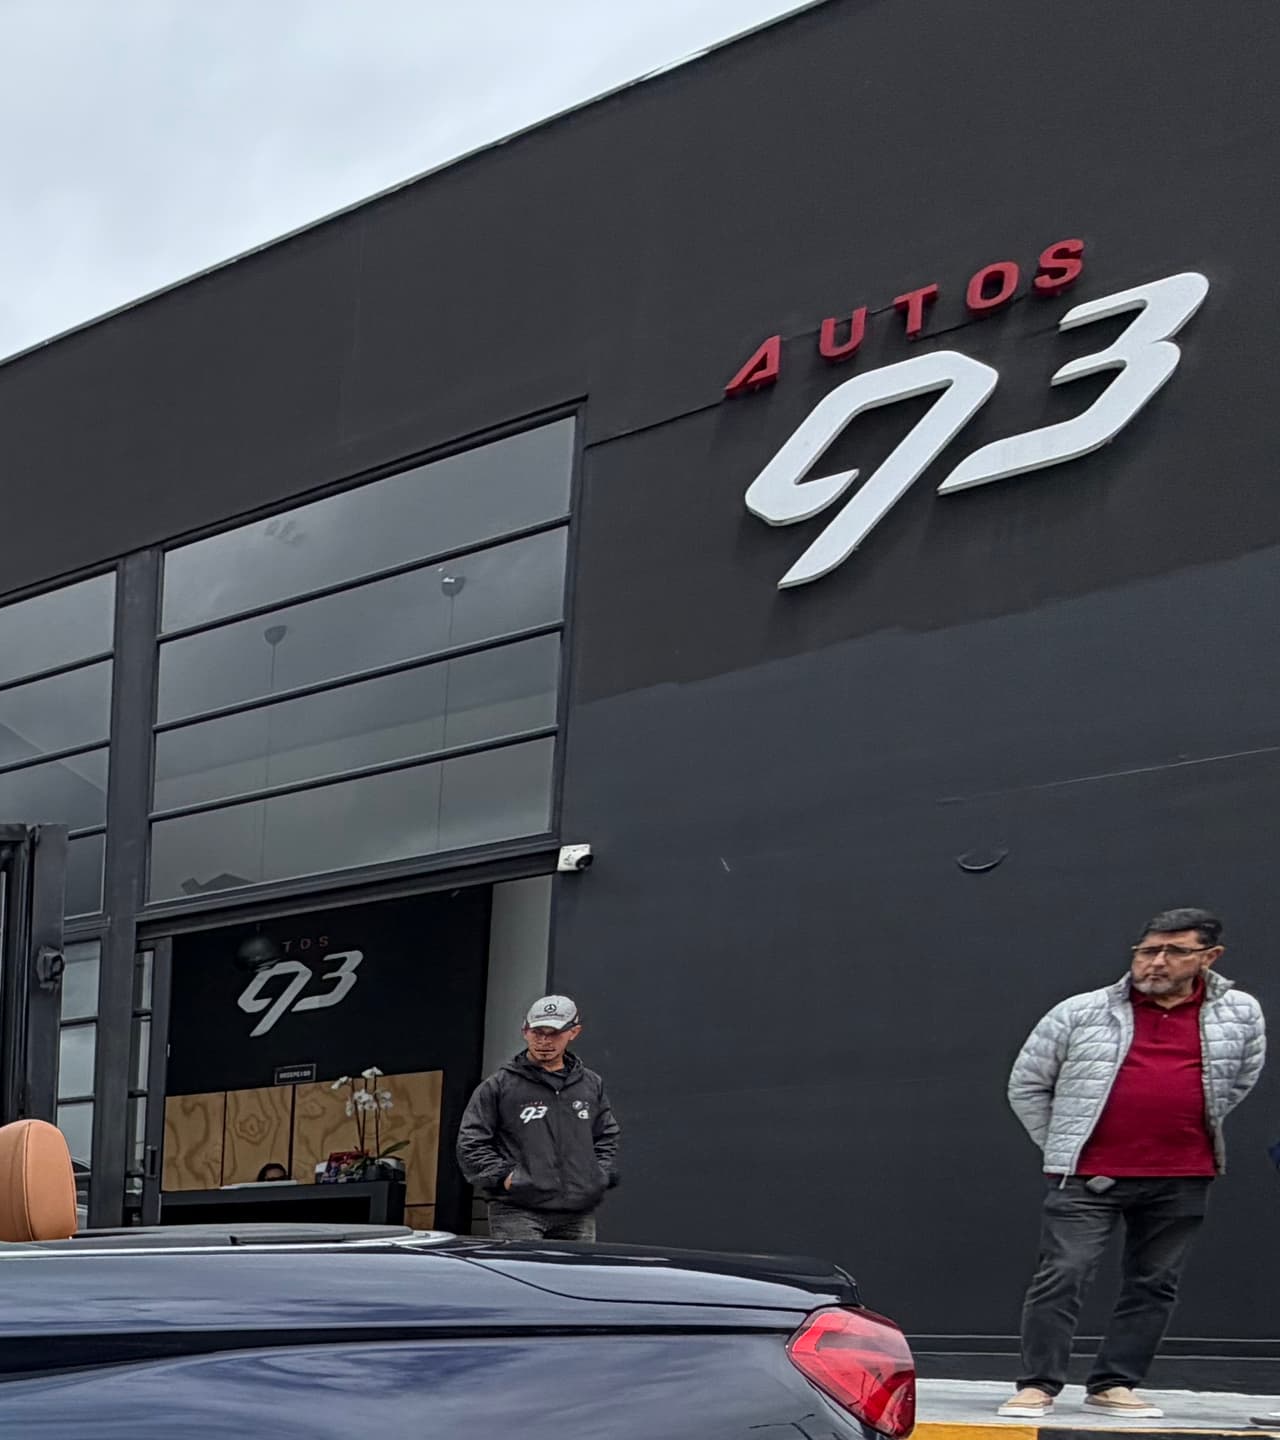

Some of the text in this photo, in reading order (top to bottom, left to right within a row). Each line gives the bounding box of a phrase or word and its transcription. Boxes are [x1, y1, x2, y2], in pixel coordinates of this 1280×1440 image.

[724, 238, 1085, 397] AUTOS
[744, 271, 1210, 590] 93
[237, 950, 364, 1038] 93
[520, 1106, 548, 1124] 93
